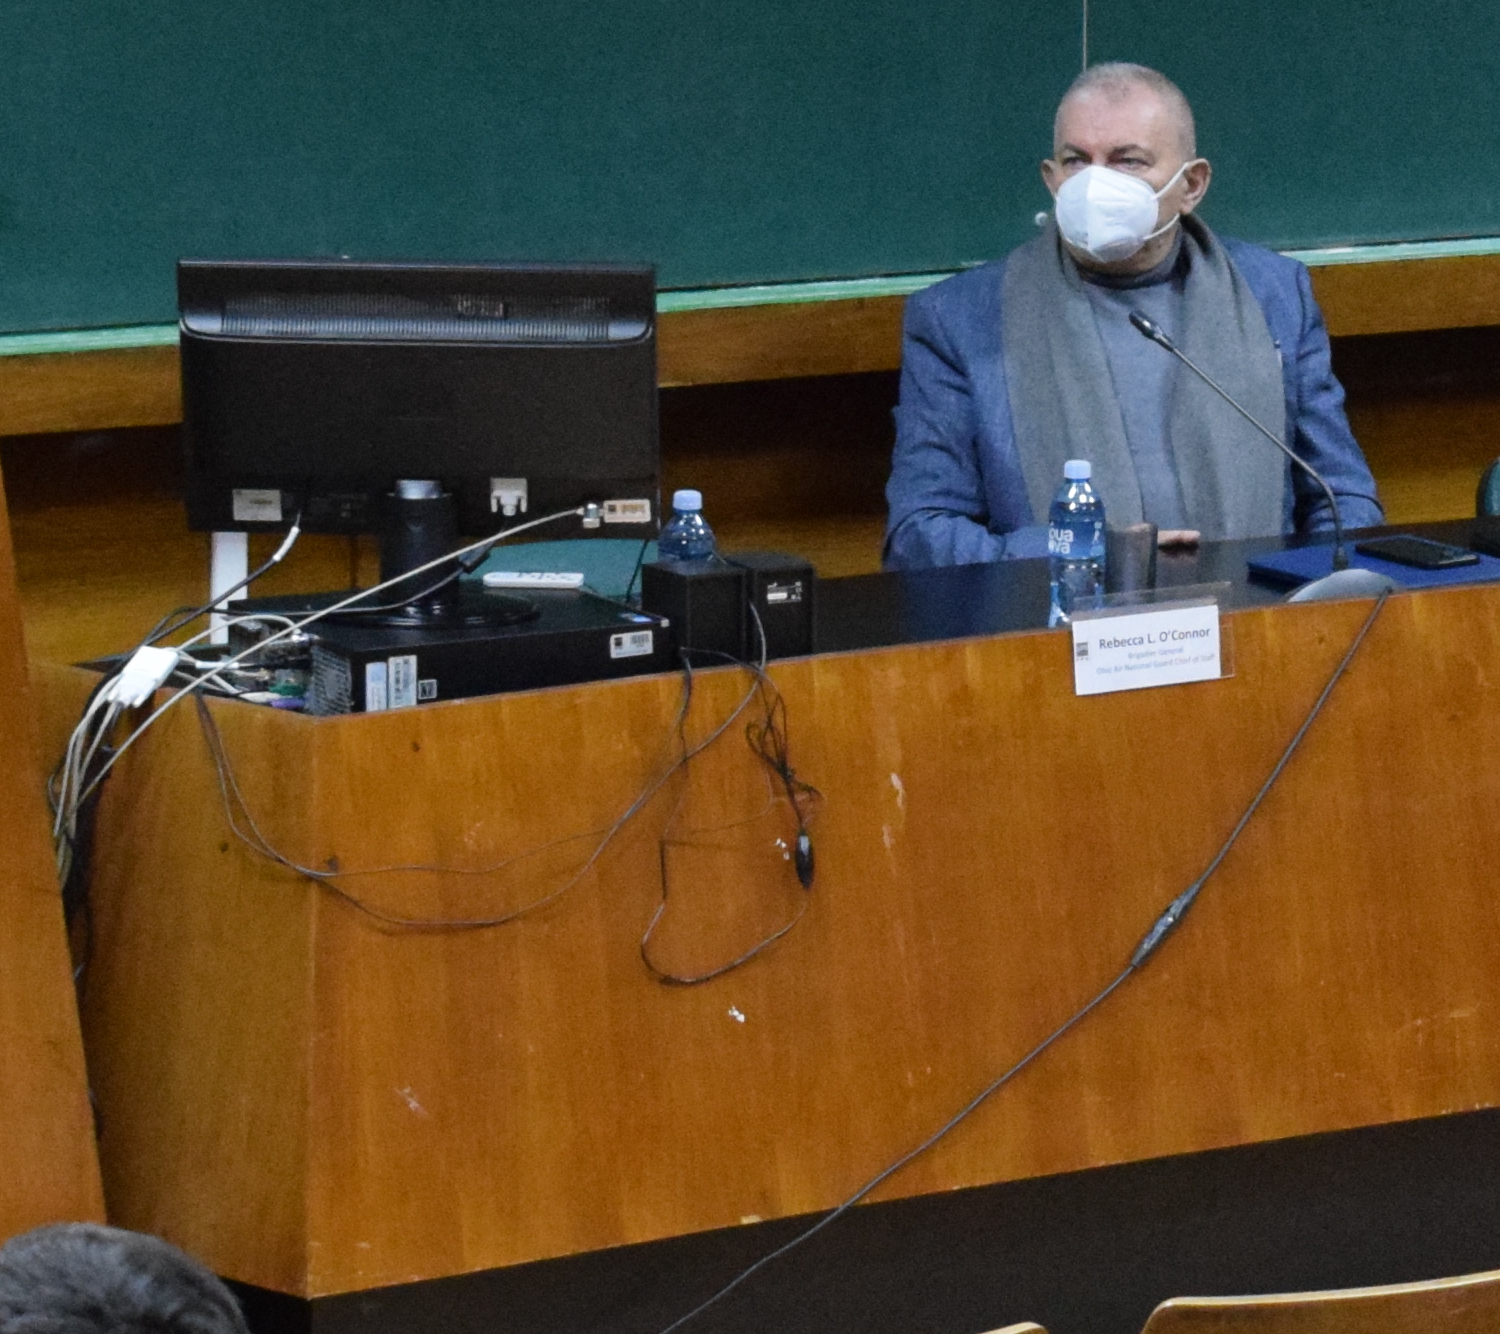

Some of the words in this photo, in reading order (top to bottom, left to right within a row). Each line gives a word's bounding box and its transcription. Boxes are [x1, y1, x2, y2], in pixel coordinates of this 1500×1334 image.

[1099, 636, 1144, 649] Rebecca
[1147, 633, 1156, 645] L.
[1159, 628, 1211, 642] O'Connor
[1158, 646, 1184, 656] General
[1174, 655, 1191, 665] Chief
[1201, 652, 1215, 662] Staff
